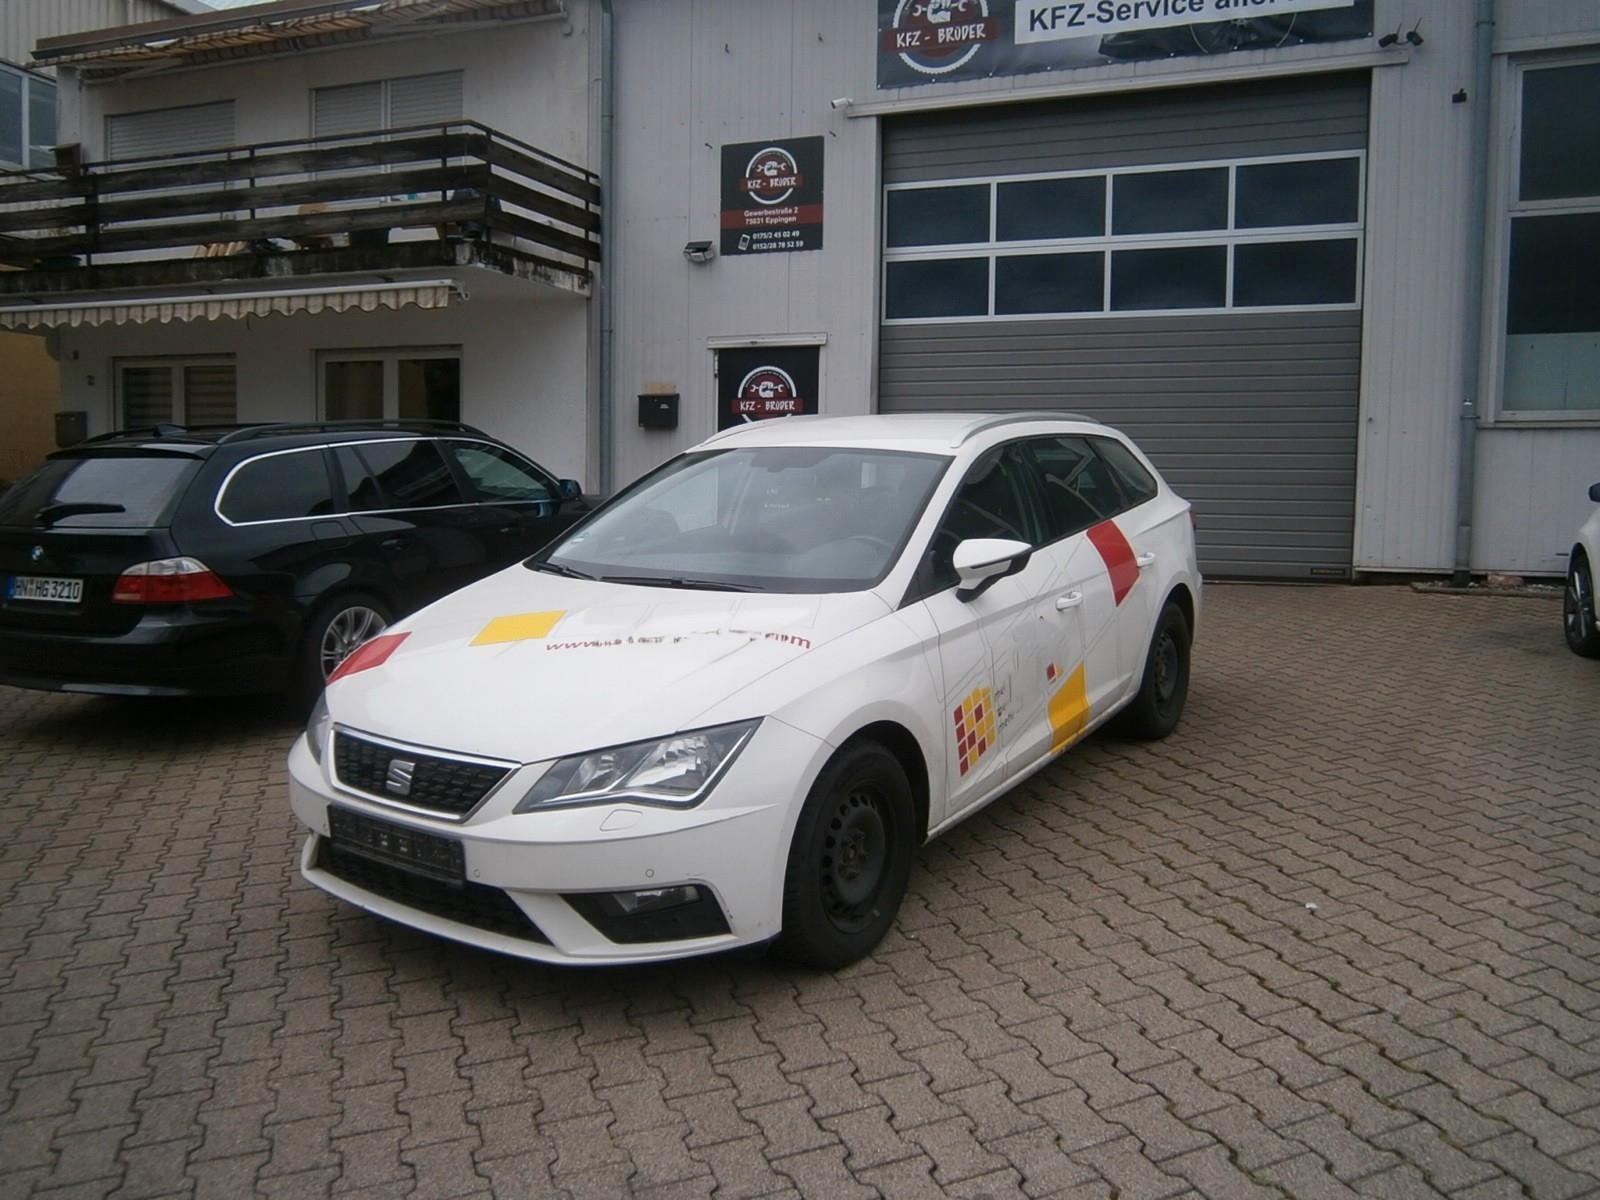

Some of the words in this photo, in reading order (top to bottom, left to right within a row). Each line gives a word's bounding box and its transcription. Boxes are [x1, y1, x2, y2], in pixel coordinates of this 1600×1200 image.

[1029, 0, 1204, 32] KFZ-Service
[896, 30, 921, 48] KFZ
[740, 400, 756, 411] KFZ
[50, 580, 81, 600] 3210
